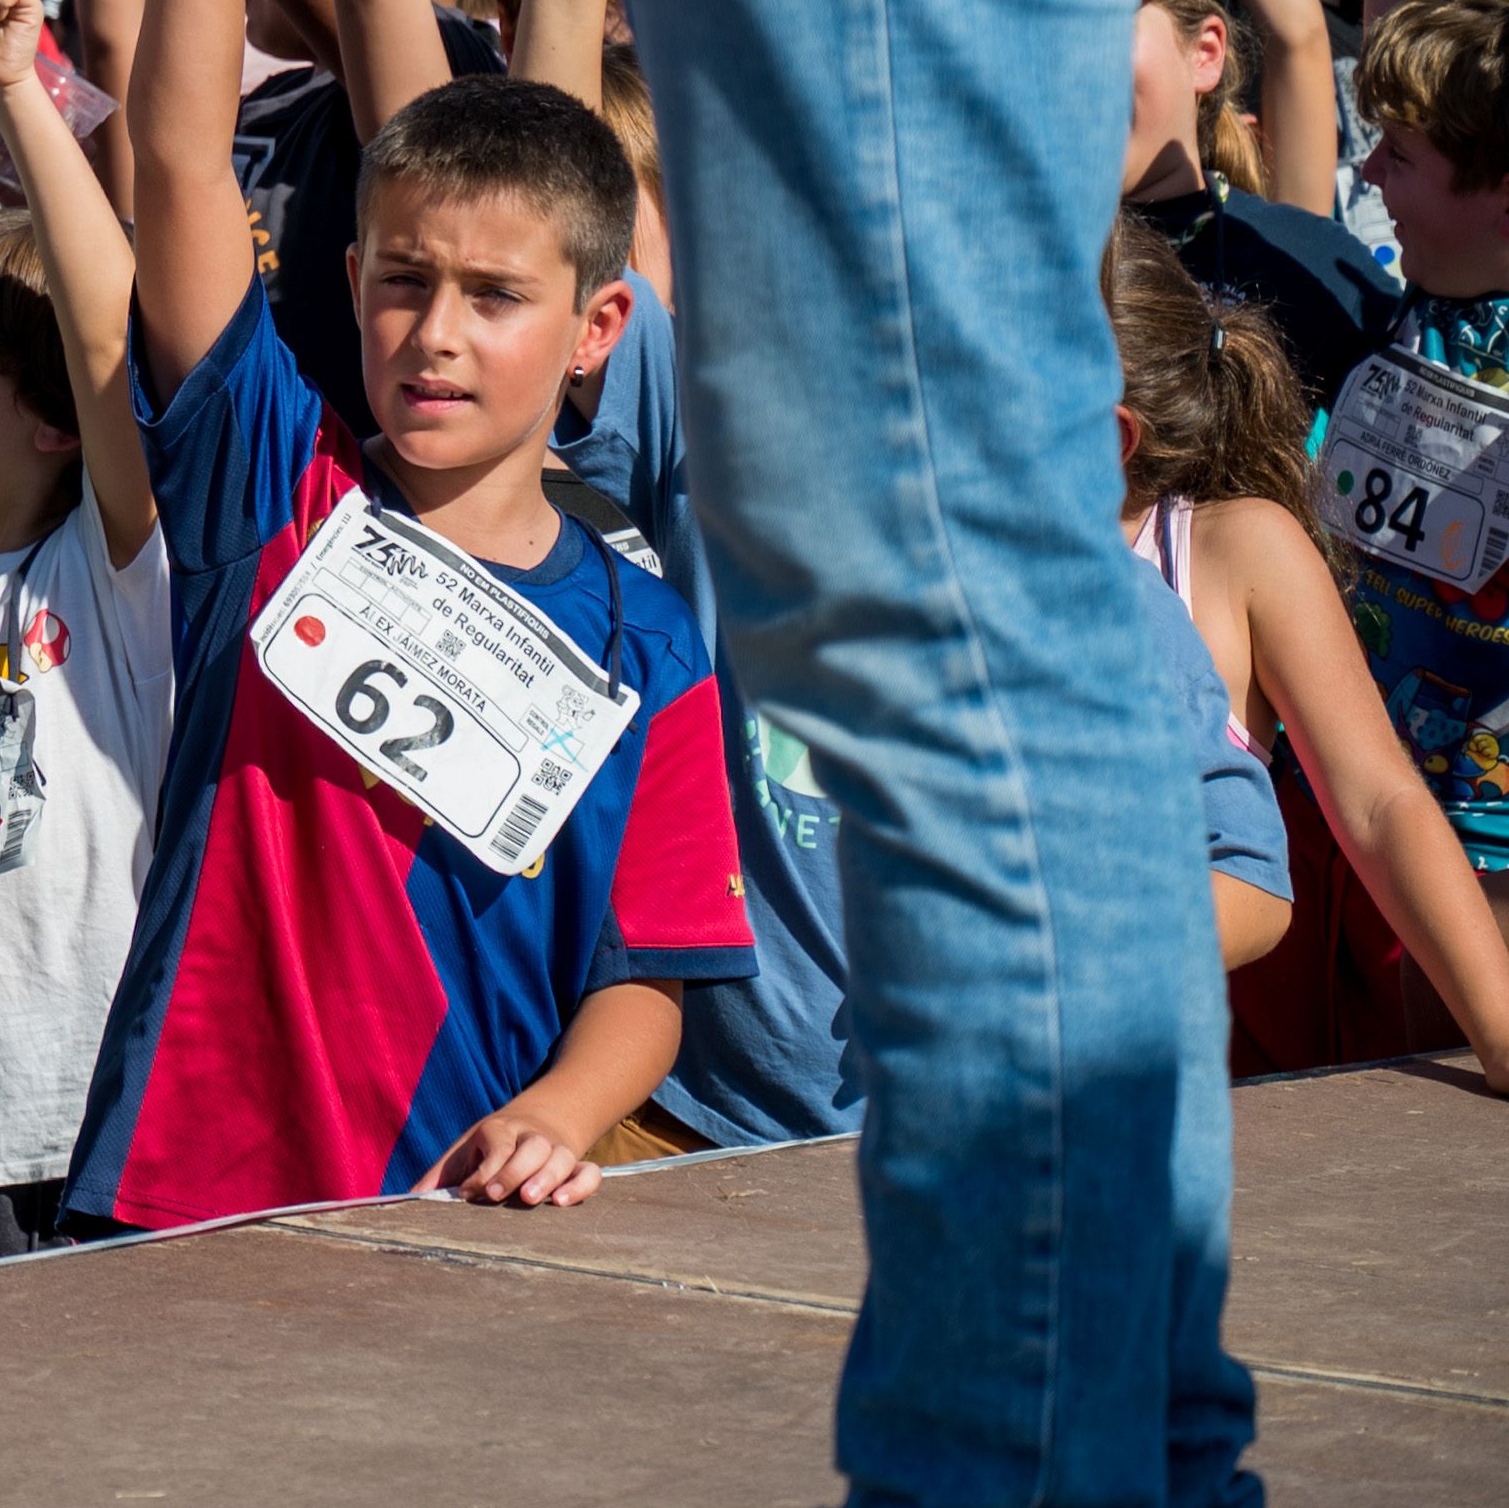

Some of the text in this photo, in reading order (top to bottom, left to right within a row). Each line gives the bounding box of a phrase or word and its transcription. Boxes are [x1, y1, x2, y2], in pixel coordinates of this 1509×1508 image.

[1402, 402, 1475, 441] de Regularitat
[1418, 384, 1443, 408] Marxa
[1446, 398, 1487, 424] Infantil
[1354, 468, 1429, 553] 84
[435, 571, 556, 676] 52 Marxa Infantil
[459, 563, 476, 578] NO
[489, 583, 550, 640] PLASTIFIQUIS
[1395, 587, 1443, 620] SUPER
[1445, 614, 1509, 647] HEROES
[432, 597, 536, 689] de Regularitat
[336, 659, 454, 783] 62
[438, 665, 486, 713] MORATA
